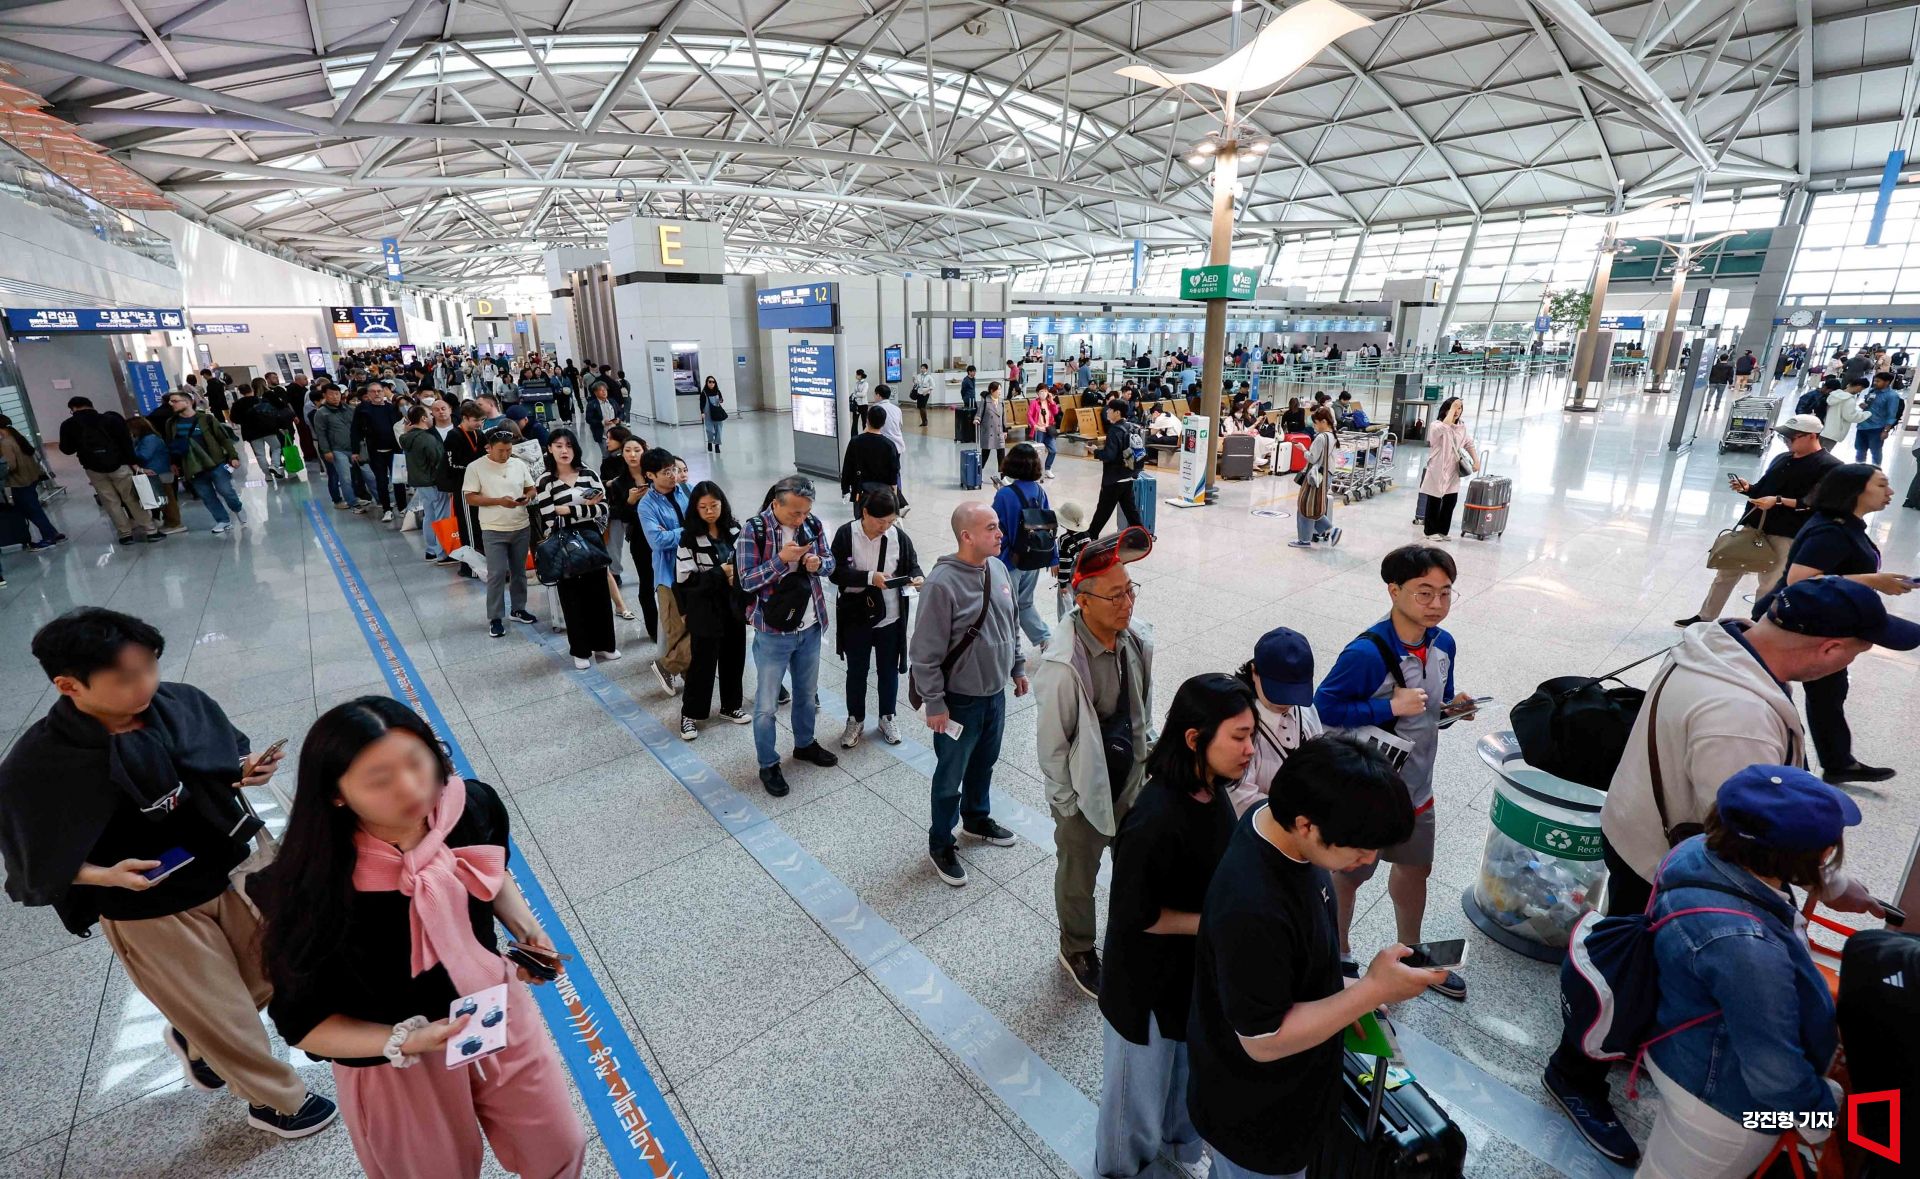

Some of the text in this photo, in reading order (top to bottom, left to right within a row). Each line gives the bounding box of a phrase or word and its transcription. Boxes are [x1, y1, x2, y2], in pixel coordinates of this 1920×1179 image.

[386, 243, 396, 255] 2
[658, 225, 685, 266] E
[1202, 275, 1219, 283] AED
[1241, 276, 1252, 284] AED
[478, 300, 492, 315] D
[37, 311, 77, 320] 세관신고
[338, 311, 348, 320] 2
[588, 1046, 665, 1161] 스마트패스 전용
